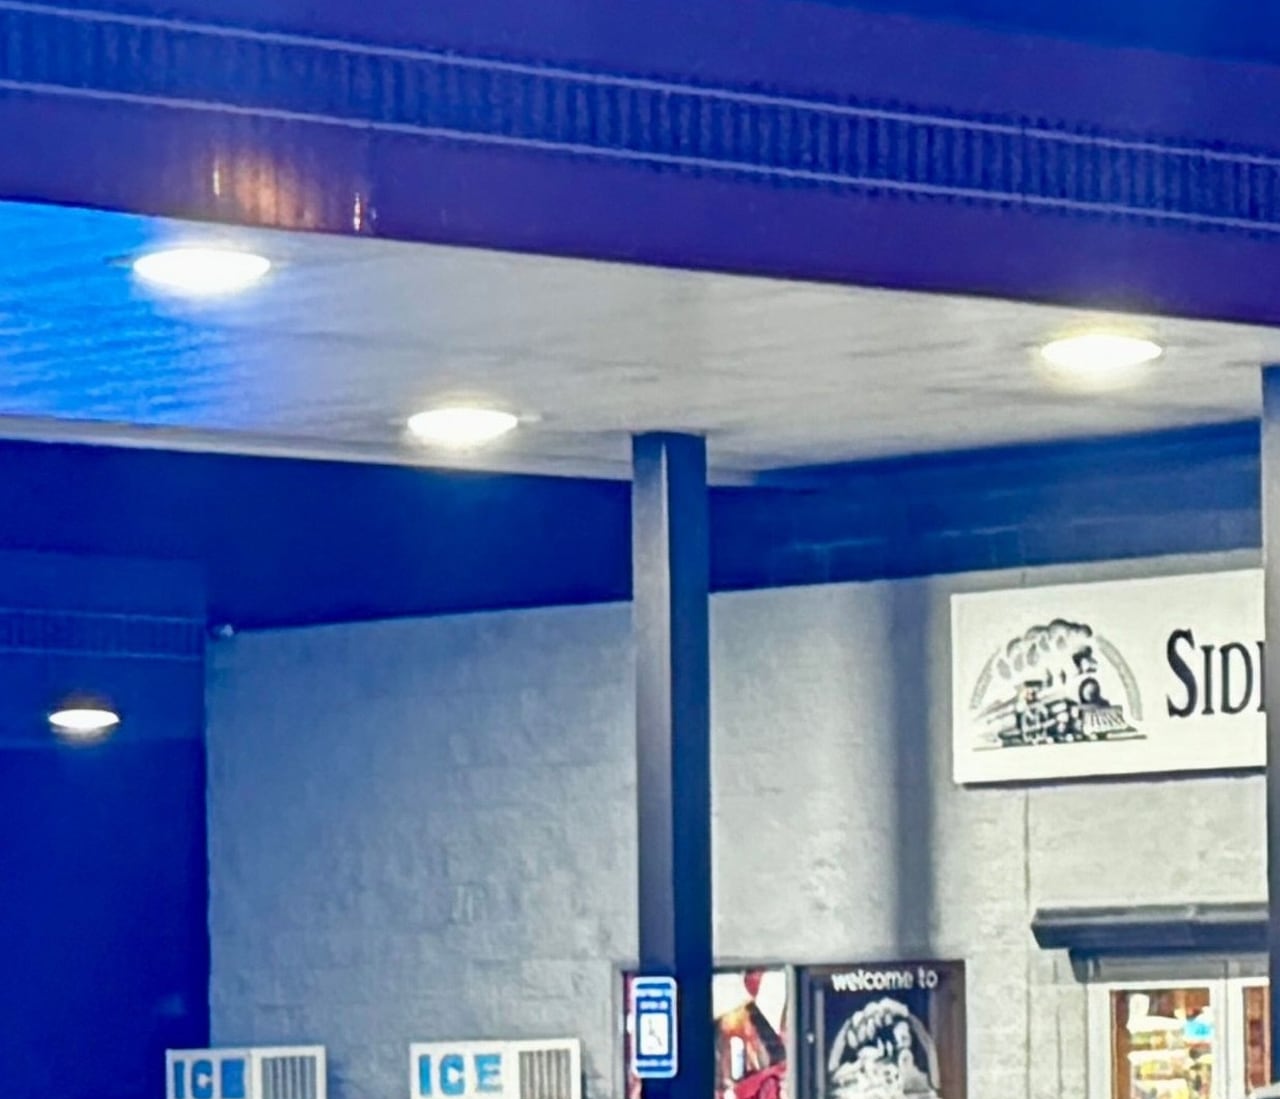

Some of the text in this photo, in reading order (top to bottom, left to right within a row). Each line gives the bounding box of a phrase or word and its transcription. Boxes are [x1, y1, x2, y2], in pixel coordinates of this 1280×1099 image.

[831, 967, 938, 992] welcome to
[417, 1053, 504, 1097] ICE
